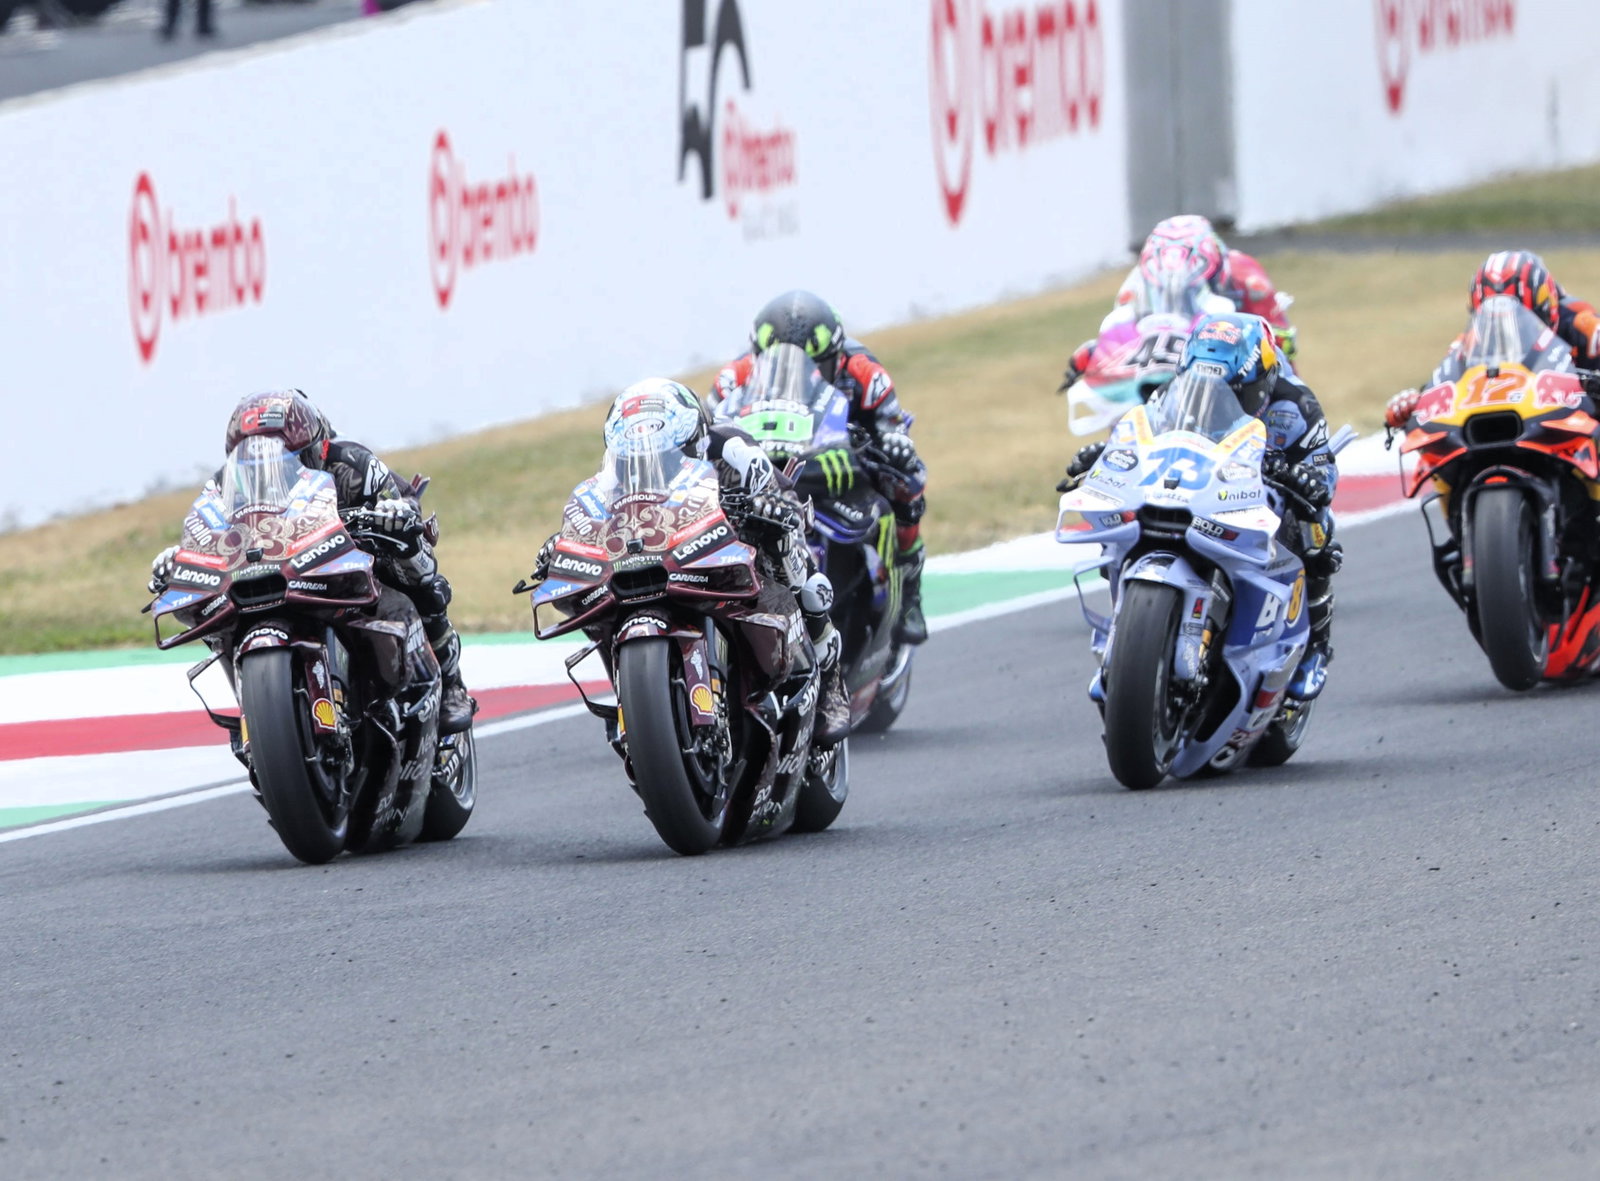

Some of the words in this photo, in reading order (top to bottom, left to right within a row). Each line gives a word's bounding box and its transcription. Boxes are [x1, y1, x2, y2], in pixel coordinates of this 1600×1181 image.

[455, 154, 539, 268] brembo
[165, 196, 266, 321] brembo
[1463, 370, 1528, 405] 12
[1139, 447, 1216, 490] 73
[1218, 490, 1261, 501] Unibat
[1192, 516, 1224, 535] BOLD
[290, 535, 345, 568] Lenovo
[672, 526, 728, 560] Lenovo
[554, 555, 602, 576] Lenovo
[173, 566, 221, 586] Lenovo
[288, 580, 327, 590] CARRERA
[669, 573, 709, 583] CARRERA
[171, 594, 193, 607] TIM
[551, 584, 572, 597] TIM
